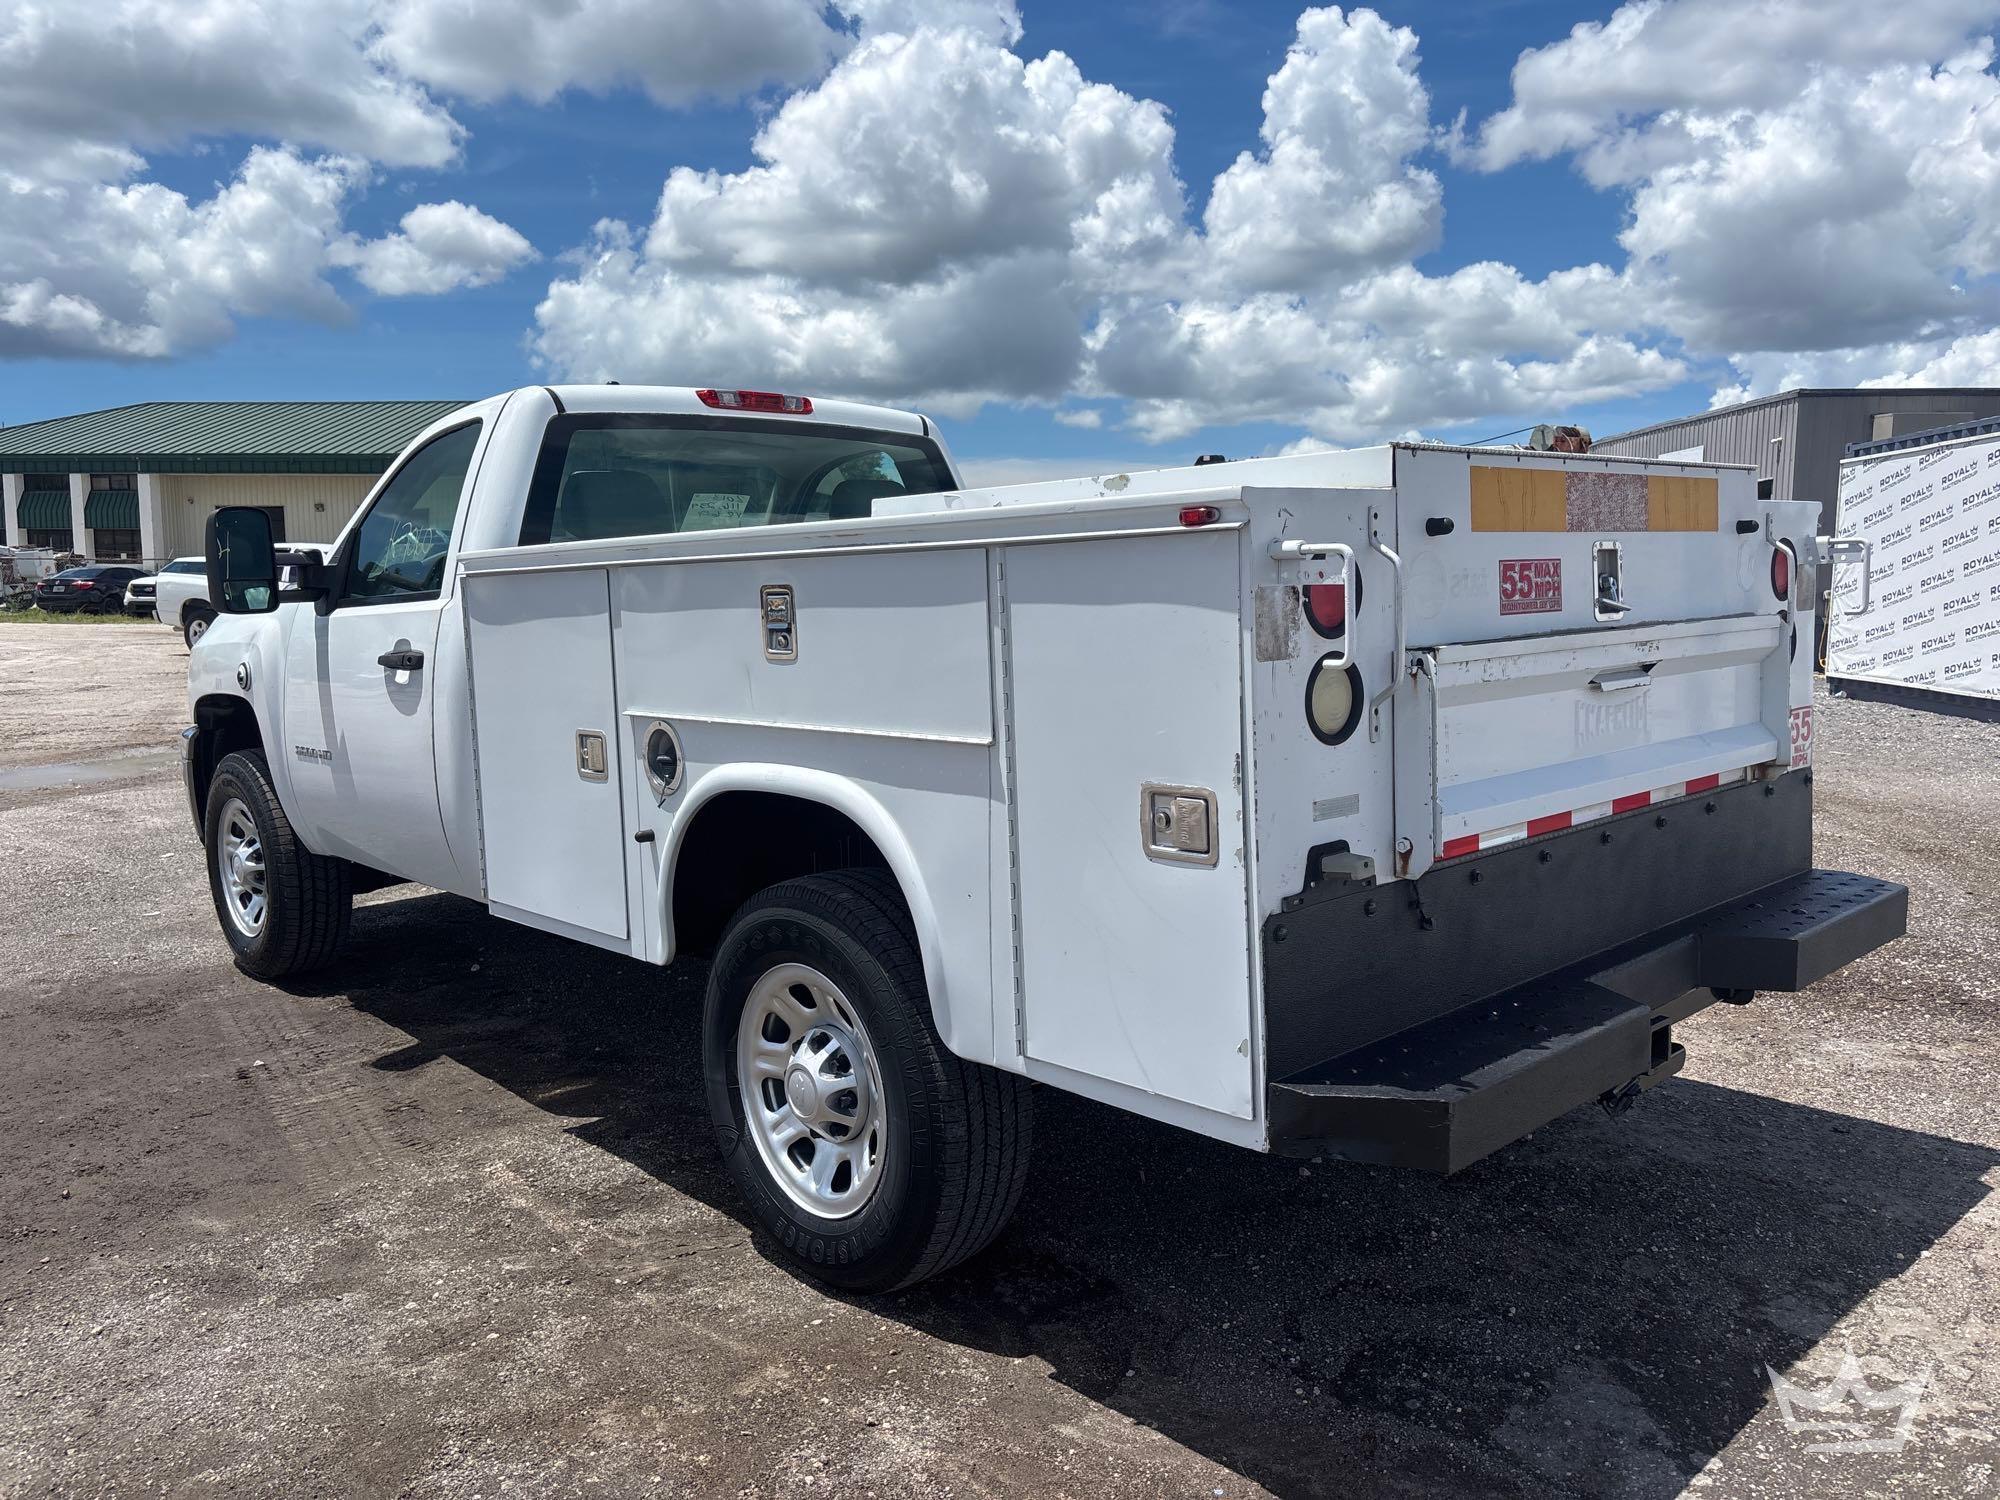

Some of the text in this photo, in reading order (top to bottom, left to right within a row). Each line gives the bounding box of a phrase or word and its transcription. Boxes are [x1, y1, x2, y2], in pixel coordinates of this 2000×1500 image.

[1919, 447, 1945, 466] ROYAL
[1880, 469, 1904, 487] ROYAL
[1942, 465, 1969, 485] ROYAL
[1845, 490, 1867, 506] ROYAL
[1901, 488, 1926, 506] ROYAL
[1963, 488, 1992, 507] ROYAL
[1864, 508, 1886, 524] ROYAL
[1920, 509, 1946, 527] ROYAL
[1881, 529, 1905, 545] ROYAL
[1943, 530, 1970, 548] ROYAL
[1902, 549, 1926, 565] ROYAL
[1964, 554, 1994, 571] ROYAL
[1535, 563, 1560, 577] MAX
[1870, 566, 1887, 579] OYAL
[1502, 563, 1533, 600] 55
[1834, 581, 1851, 593] OYAL
[1921, 572, 1947, 588] ROYAL
[1535, 581, 1560, 598] MPH
[1882, 588, 1906, 603] ROYAL
[1944, 595, 1972, 611] ROYAL
[1903, 611, 1927, 625] ROYAL
[1866, 624, 1888, 638] ROYAL
[1965, 621, 1996, 636] ROYAL
[1831, 637, 1852, 649] ROYAL
[1921, 635, 1948, 649] ROYAL
[1883, 648, 1906, 661] ROYAL
[1847, 659, 1869, 671] ROYAL
[1944, 661, 1973, 674] ROYAL
[1791, 710, 1811, 744] 55
[1792, 753, 1808, 768] MPH
